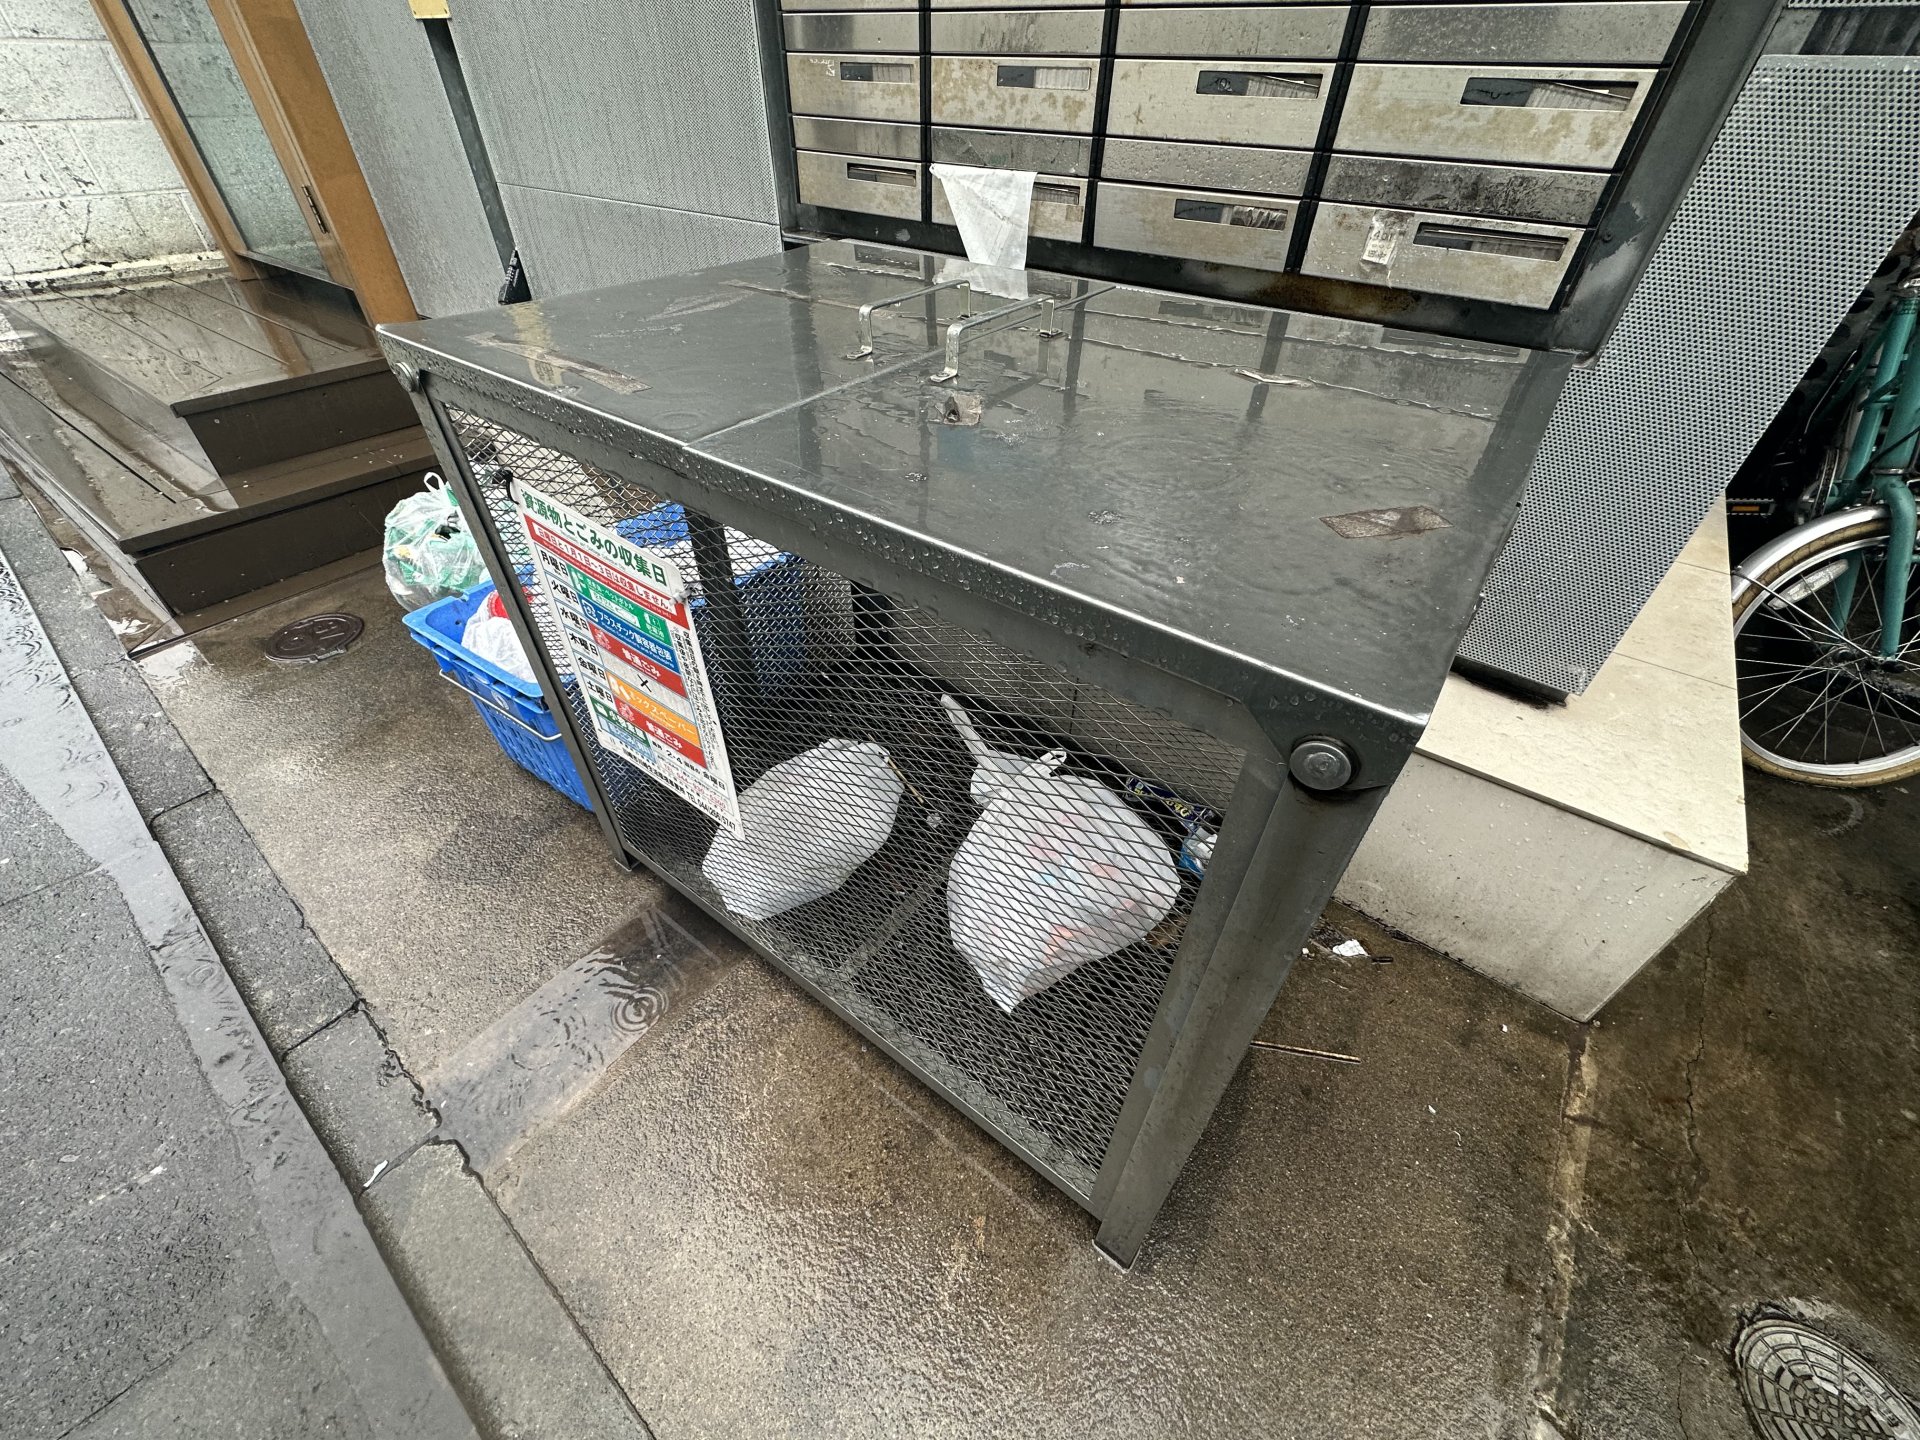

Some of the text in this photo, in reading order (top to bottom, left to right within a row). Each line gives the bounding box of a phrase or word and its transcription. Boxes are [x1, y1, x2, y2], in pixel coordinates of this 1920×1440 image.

[519, 487, 668, 589] 資源物とごみの収集日
[539, 549, 569, 577] 月曜日
[549, 577, 580, 605] 火曜日
[558, 604, 590, 632] 水曜日
[567, 628, 599, 658] 木曜日
[576, 654, 607, 682] 金曜日
[621, 646, 663, 680] 普通ごみ
[585, 678, 614, 704] 土曜日
[628, 689, 697, 740] ミックスペーパー
[644, 718, 684, 752] 普通ごみ
[701, 769, 727, 792] 金曜日
